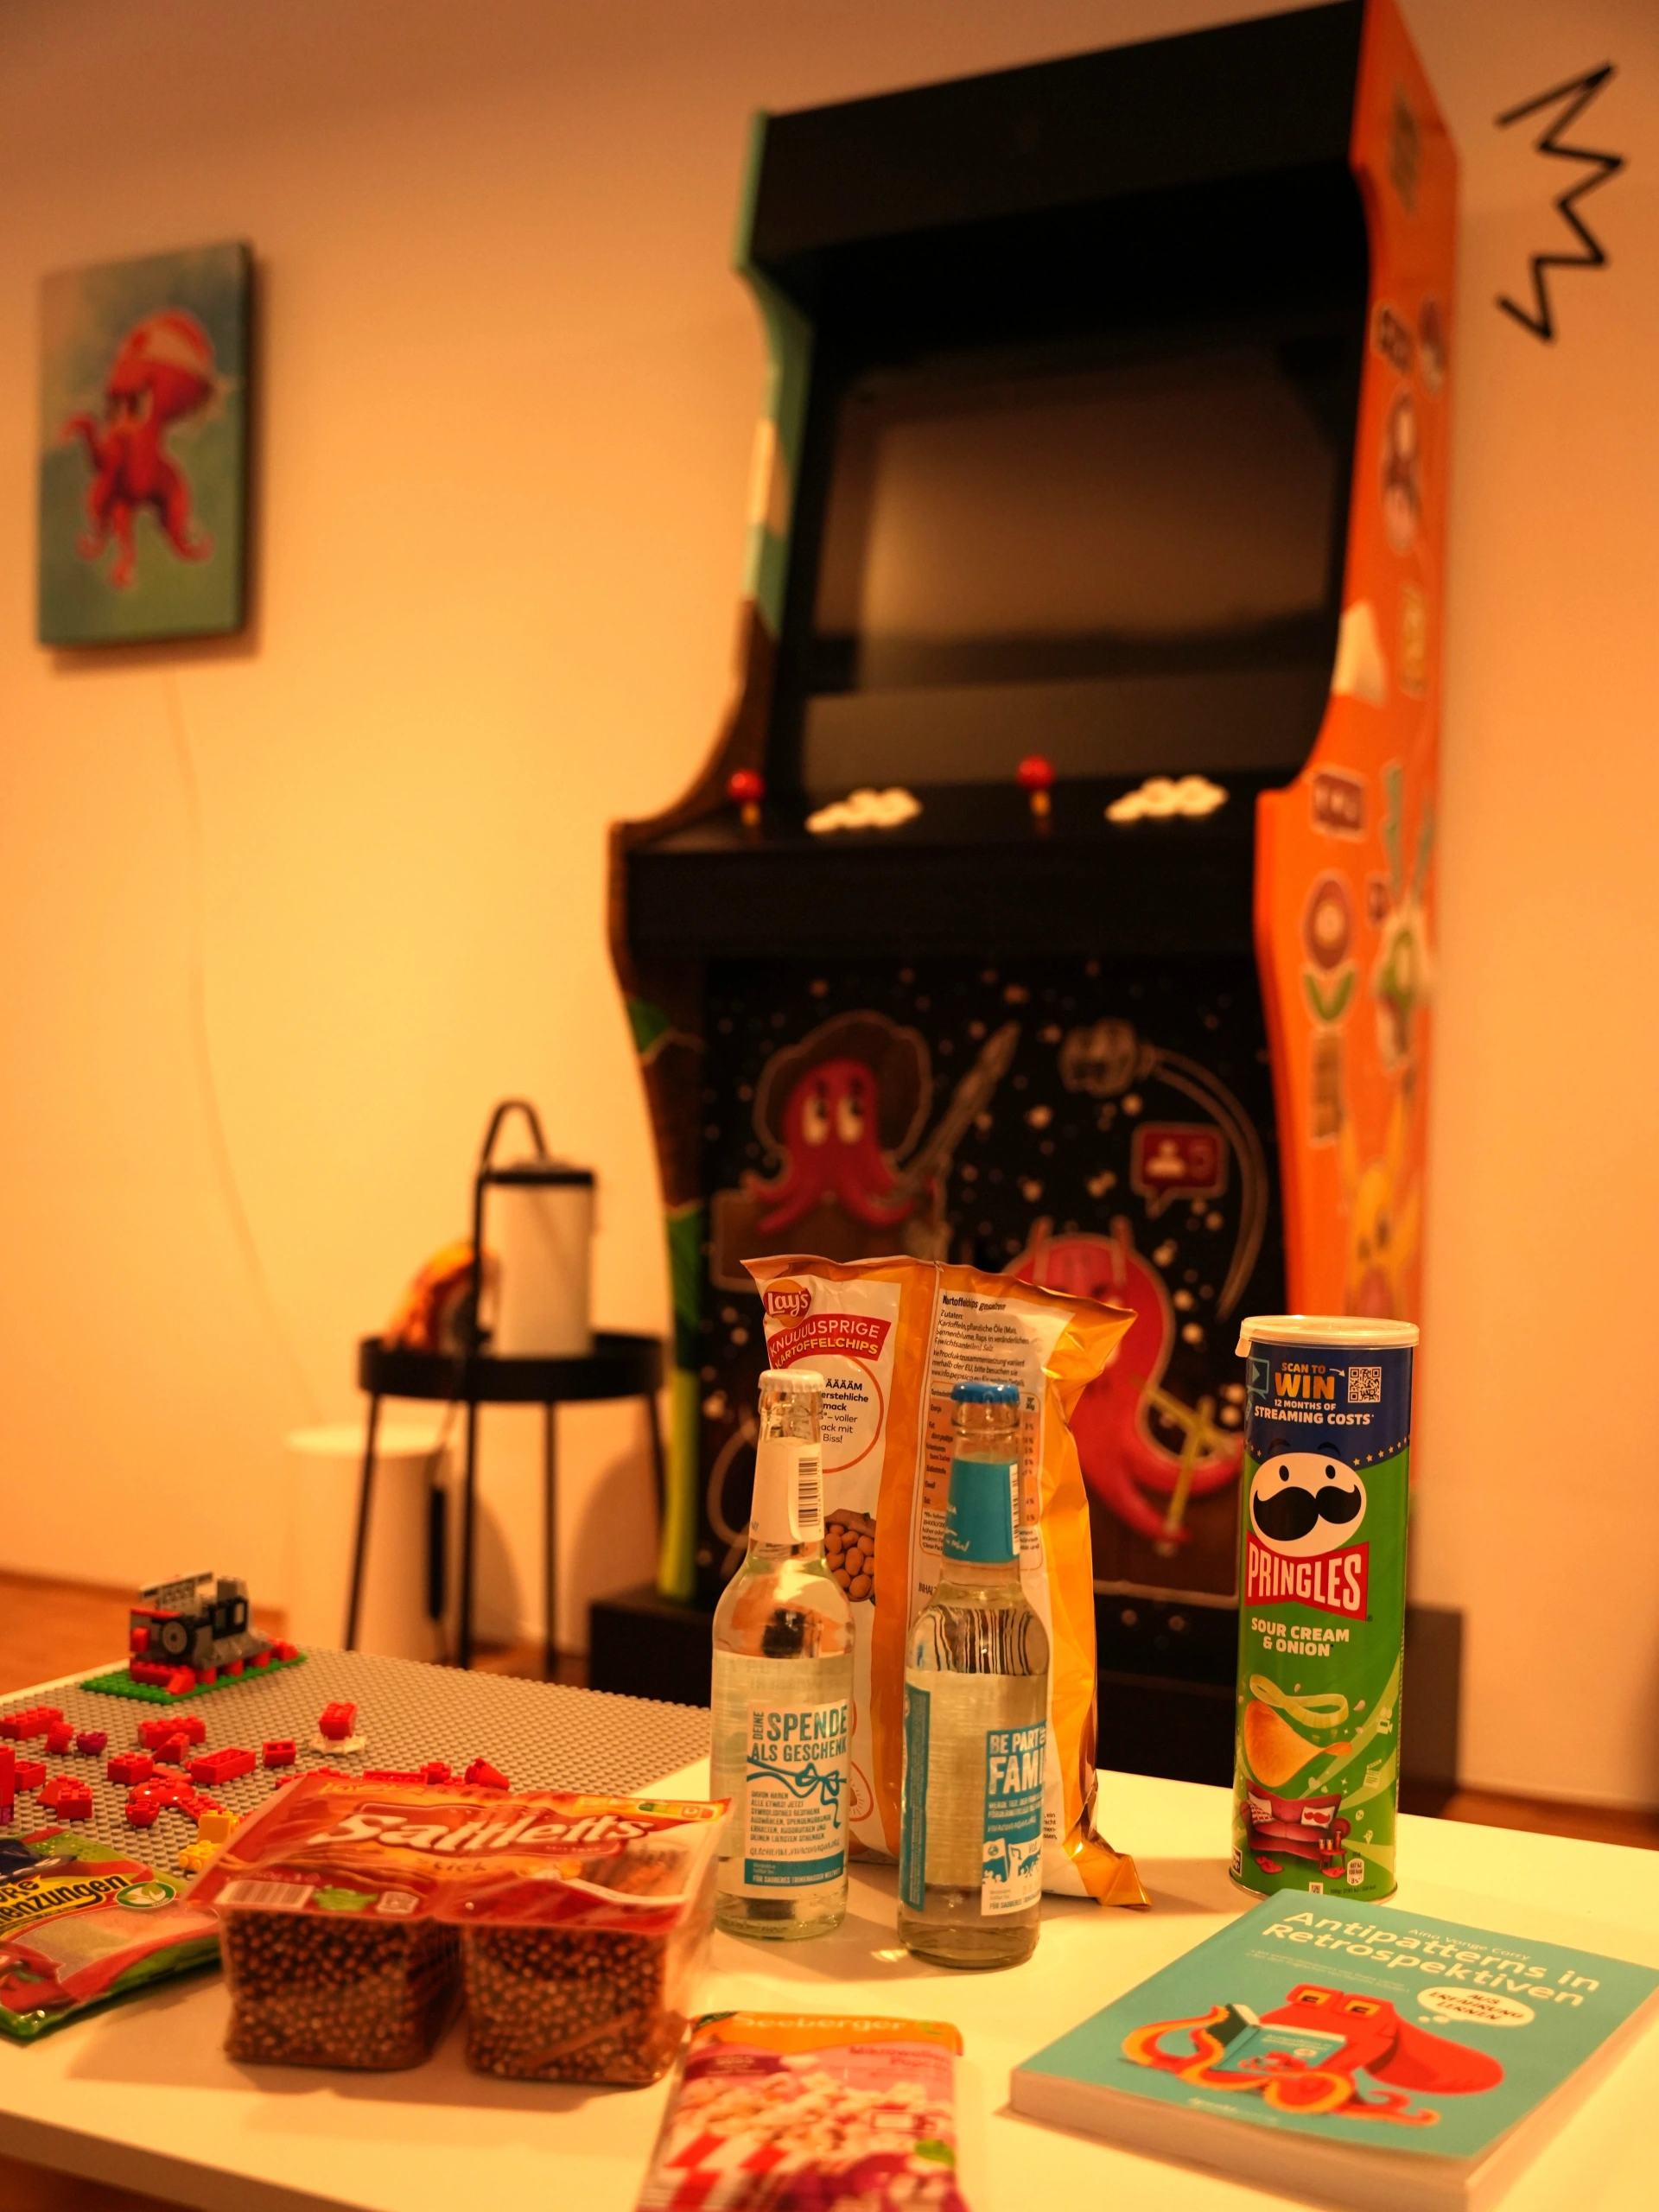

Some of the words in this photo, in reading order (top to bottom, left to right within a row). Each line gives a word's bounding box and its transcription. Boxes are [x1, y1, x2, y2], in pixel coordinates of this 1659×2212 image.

[767, 1291, 810, 1318] Lay's
[769, 1319, 880, 1359] KNUUUUSPRIGE
[774, 1337, 880, 1370] KARTOFFELCHIPS
[1281, 1362, 1309, 1374] SCAN
[1311, 1363, 1326, 1374] TO
[821, 1392, 869, 1403] erstehliche
[1274, 1371, 1335, 1401] WIN
[823, 1402, 848, 1412] mack
[1254, 1405, 1324, 1424] STREAMING
[1274, 1398, 1281, 1408] 12
[1283, 1400, 1322, 1410] MONTHS
[1324, 1402, 1337, 1411] OF
[820, 1423, 836, 1432] ack
[838, 1425, 854, 1433] mit
[834, 1414, 859, 1423] voller
[823, 1433, 843, 1444] Biss!
[1247, 1541, 1362, 1611] PRINGLES
[1251, 1617, 1287, 1637] SOUR
[1290, 1624, 1350, 1643] CREAM
[1262, 1636, 1273, 1649] &
[1275, 1638, 1331, 1657] ONION
[753, 1711, 764, 1740] DEINE
[766, 1705, 847, 1742] SPENDE
[752, 1742, 779, 1762] ALS
[783, 1736, 847, 1763] GESCHENK
[989, 1733, 1009, 1754] BE
[1012, 1727, 1039, 1752] PART
[988, 1747, 1044, 1795] FAMI
[307, 1814, 655, 1851] Saltletts
[1261, 1923, 1585, 2008] Retrospektiven
[1281, 1911, 1548, 1980] Antipatterns
[1557, 1969, 1601, 1993] in
